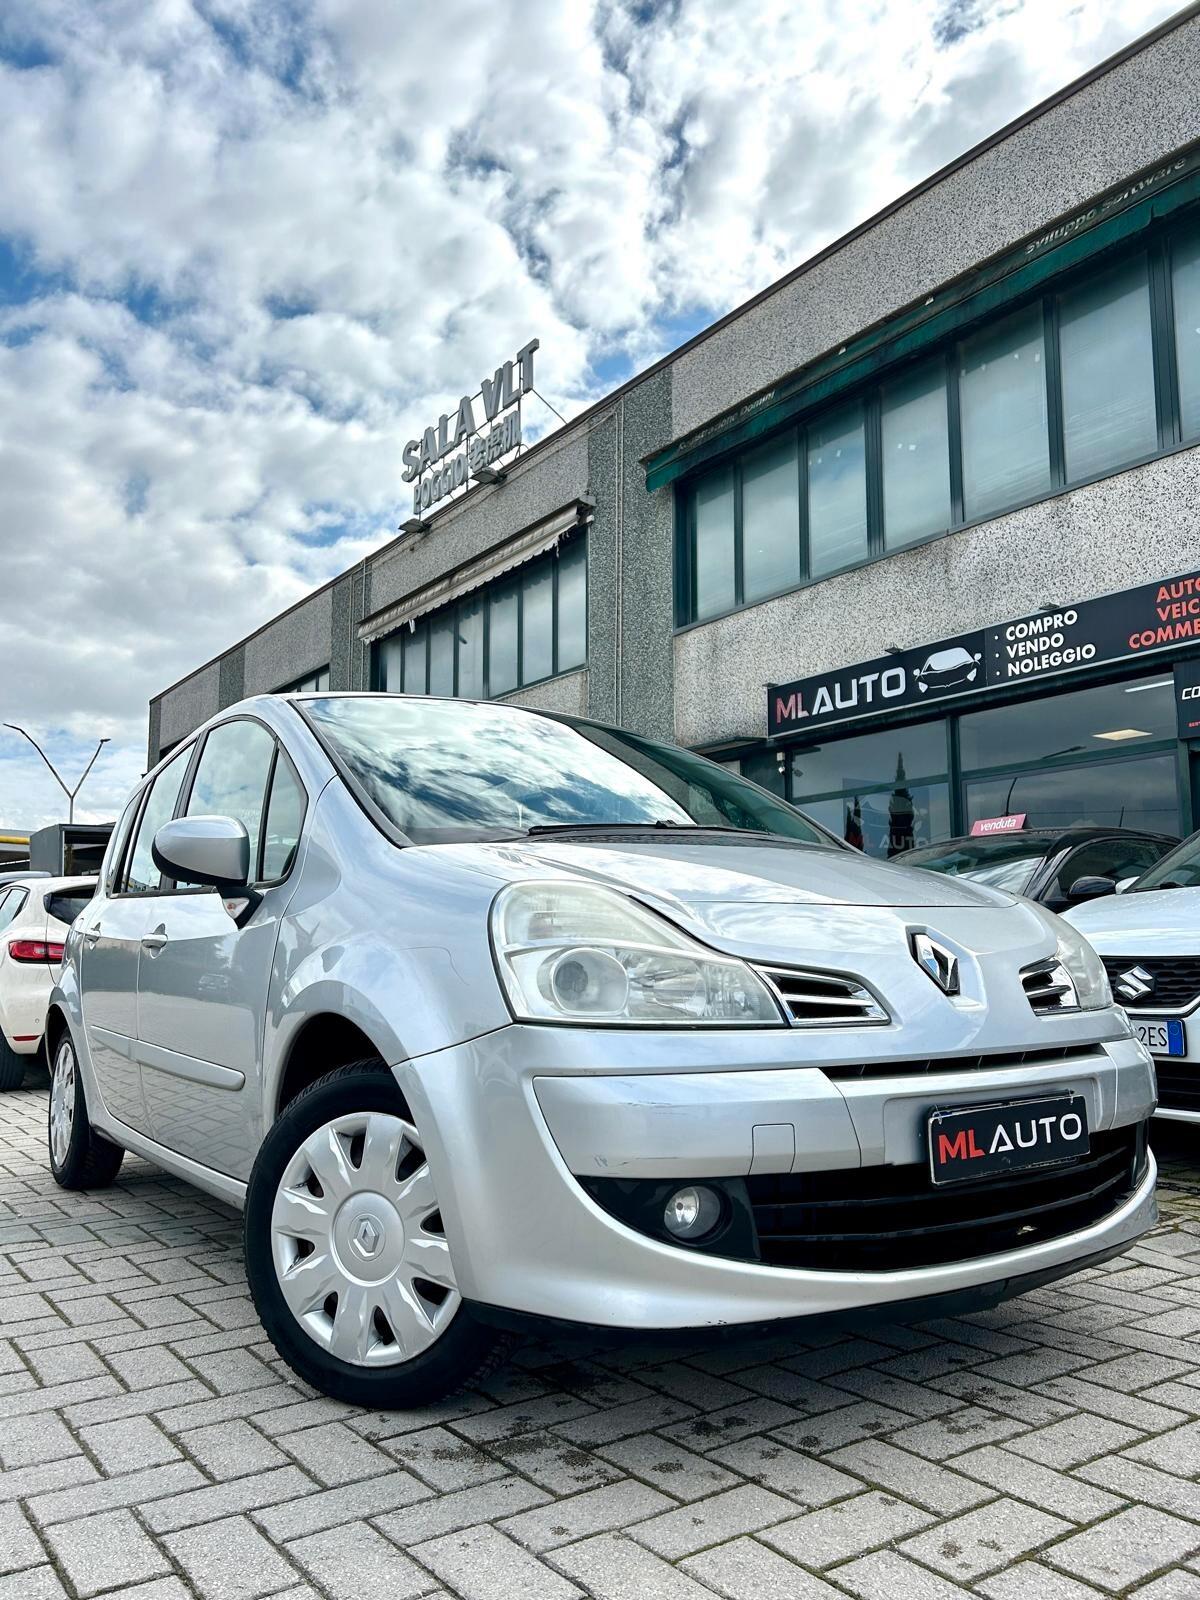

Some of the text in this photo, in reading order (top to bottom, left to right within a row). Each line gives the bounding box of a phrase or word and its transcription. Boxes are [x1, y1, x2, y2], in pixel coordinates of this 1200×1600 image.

[401, 338, 540, 482] SALA VLT
[413, 452, 468, 515] POGGIO
[1006, 610, 1078, 640] COMPRO
[1006, 632, 1064, 659] VENDO
[1007, 643, 1097, 677] NOLEGGIO
[776, 666, 906, 724] ML AUTO
[980, 817, 1016, 832] venduta
[938, 1113, 1083, 1164] ML AUTO
